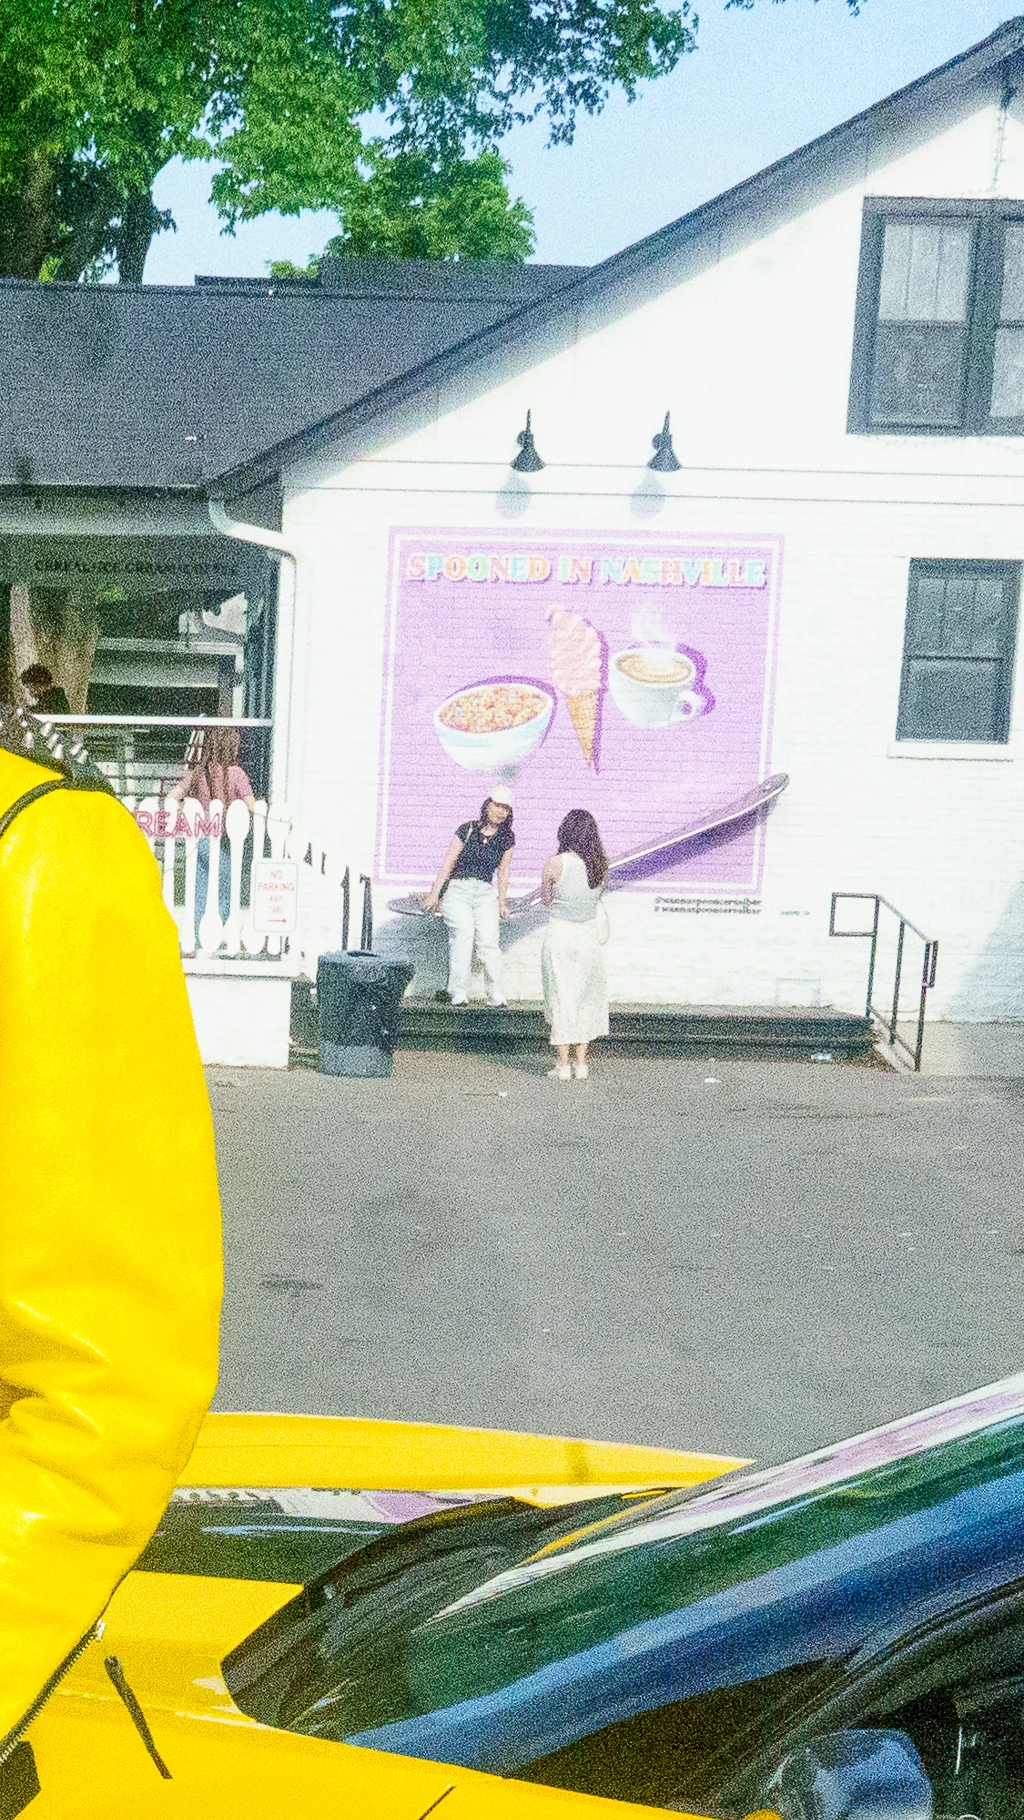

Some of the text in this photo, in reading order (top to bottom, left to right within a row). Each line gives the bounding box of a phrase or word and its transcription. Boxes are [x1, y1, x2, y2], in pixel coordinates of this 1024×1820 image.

[406, 554, 768, 589] SPOONED IN NASHVILLE
[135, 809, 222, 838] REAM
[269, 869, 283, 880] NO
[257, 882, 296, 892] PARKING
